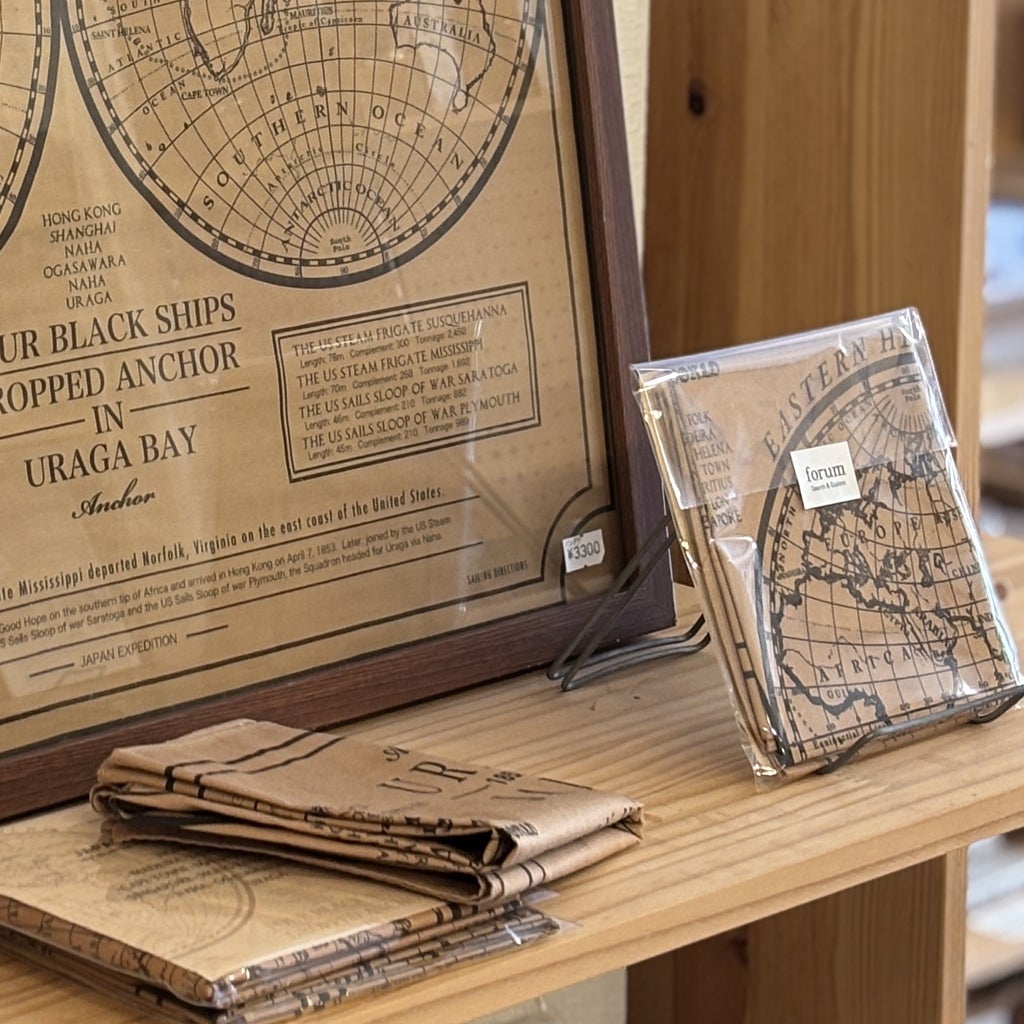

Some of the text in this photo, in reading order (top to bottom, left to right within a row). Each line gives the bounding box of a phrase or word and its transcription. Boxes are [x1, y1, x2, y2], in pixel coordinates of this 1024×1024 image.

[42, 202, 121, 228] HONG KONG
[49, 221, 117, 243] SHANGHAI
[43, 254, 126, 279] OGASAWARA
[64, 240, 102, 258] NAHA
[65, 292, 113, 310] URAGA
[68, 275, 106, 292] NAHA
[49, 308, 150, 355] BLACK
[155, 292, 237, 335] SHIPS
[375, 322, 424, 339] FRIGATE
[425, 303, 508, 331] SUSQUEHANNA
[116, 341, 241, 391] ANCHOR
[297, 371, 320, 388] THE
[322, 368, 338, 382] US
[340, 361, 378, 379] STEAM
[380, 351, 428, 371] FRIGATE
[298, 362, 519, 419] THE US SAILS SLOOP OF WAR SARATOGA
[763, 337, 866, 462] EASTERN
[91, 401, 125, 435] IN
[302, 391, 521, 450] THE US SAILS SLOOP OF WAR PLYMOUTH
[24, 424, 198, 488] URAGA BAY
[805, 464, 846, 482] forum
[71, 477, 157, 519] Anchor
[18, 566, 83, 597] Mississippi
[88, 555, 137, 580] departed
[142, 542, 189, 567] Norfolk,
[193, 534, 237, 556] Virginia
[241, 529, 255, 543] on
[259, 522, 276, 538] the
[280, 517, 302, 535] east
[307, 510, 333, 528] coast
[337, 503, 349, 520] of
[352, 497, 369, 516] the
[372, 490, 406, 512] United
[409, 485, 445, 504] States.
[567, 540, 600, 560] ¥3300
[80, 633, 178, 668] JAPAN EXPEDITION
